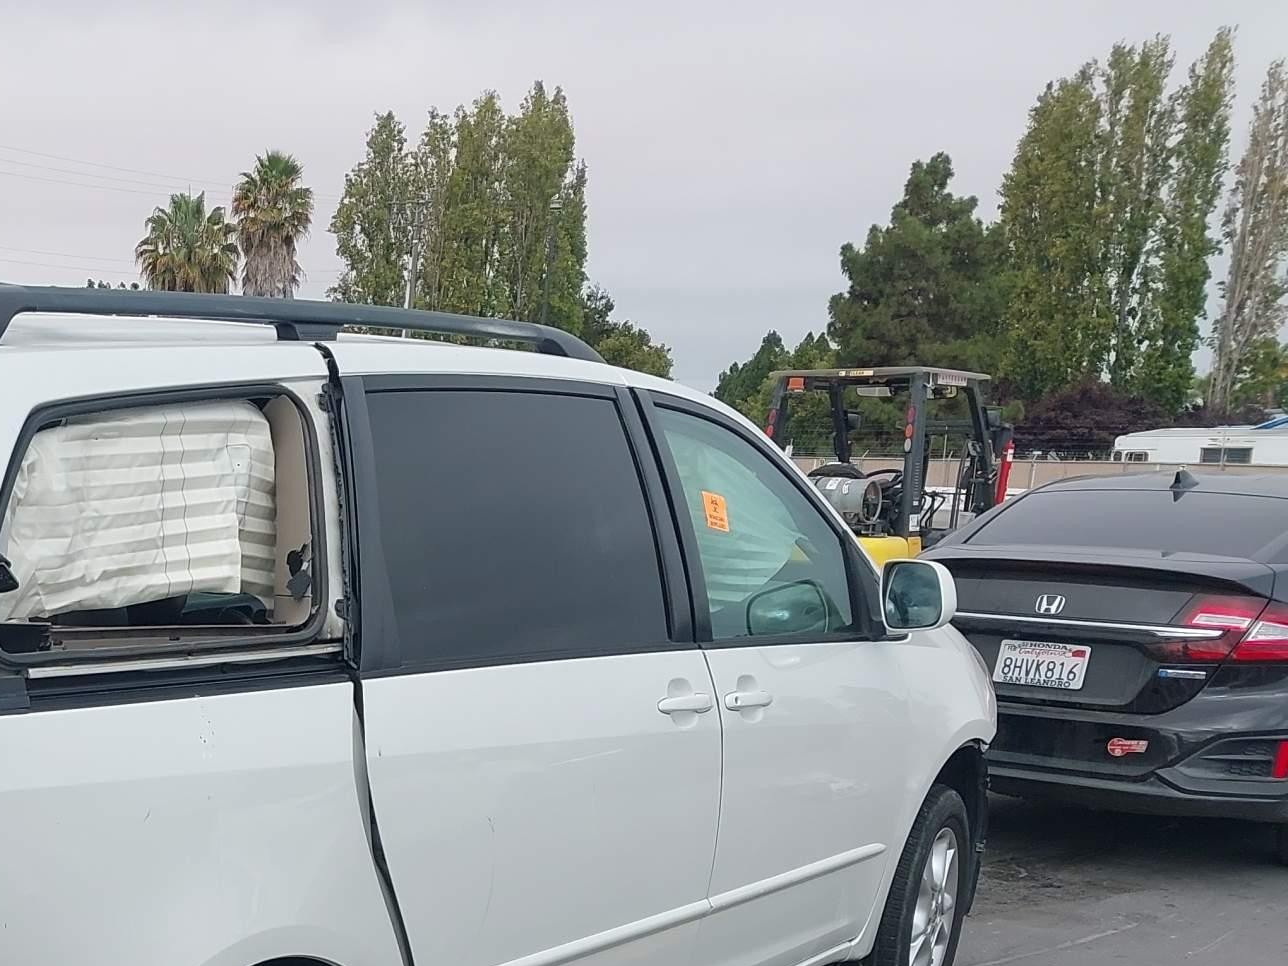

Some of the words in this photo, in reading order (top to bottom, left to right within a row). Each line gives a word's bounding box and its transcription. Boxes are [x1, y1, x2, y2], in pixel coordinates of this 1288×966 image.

[1029, 642, 1068, 651] HONDA
[1001, 657, 1081, 682] 8HVK816
[1002, 675, 1022, 683] SAN
[1024, 677, 1071, 688] LEANDRO
